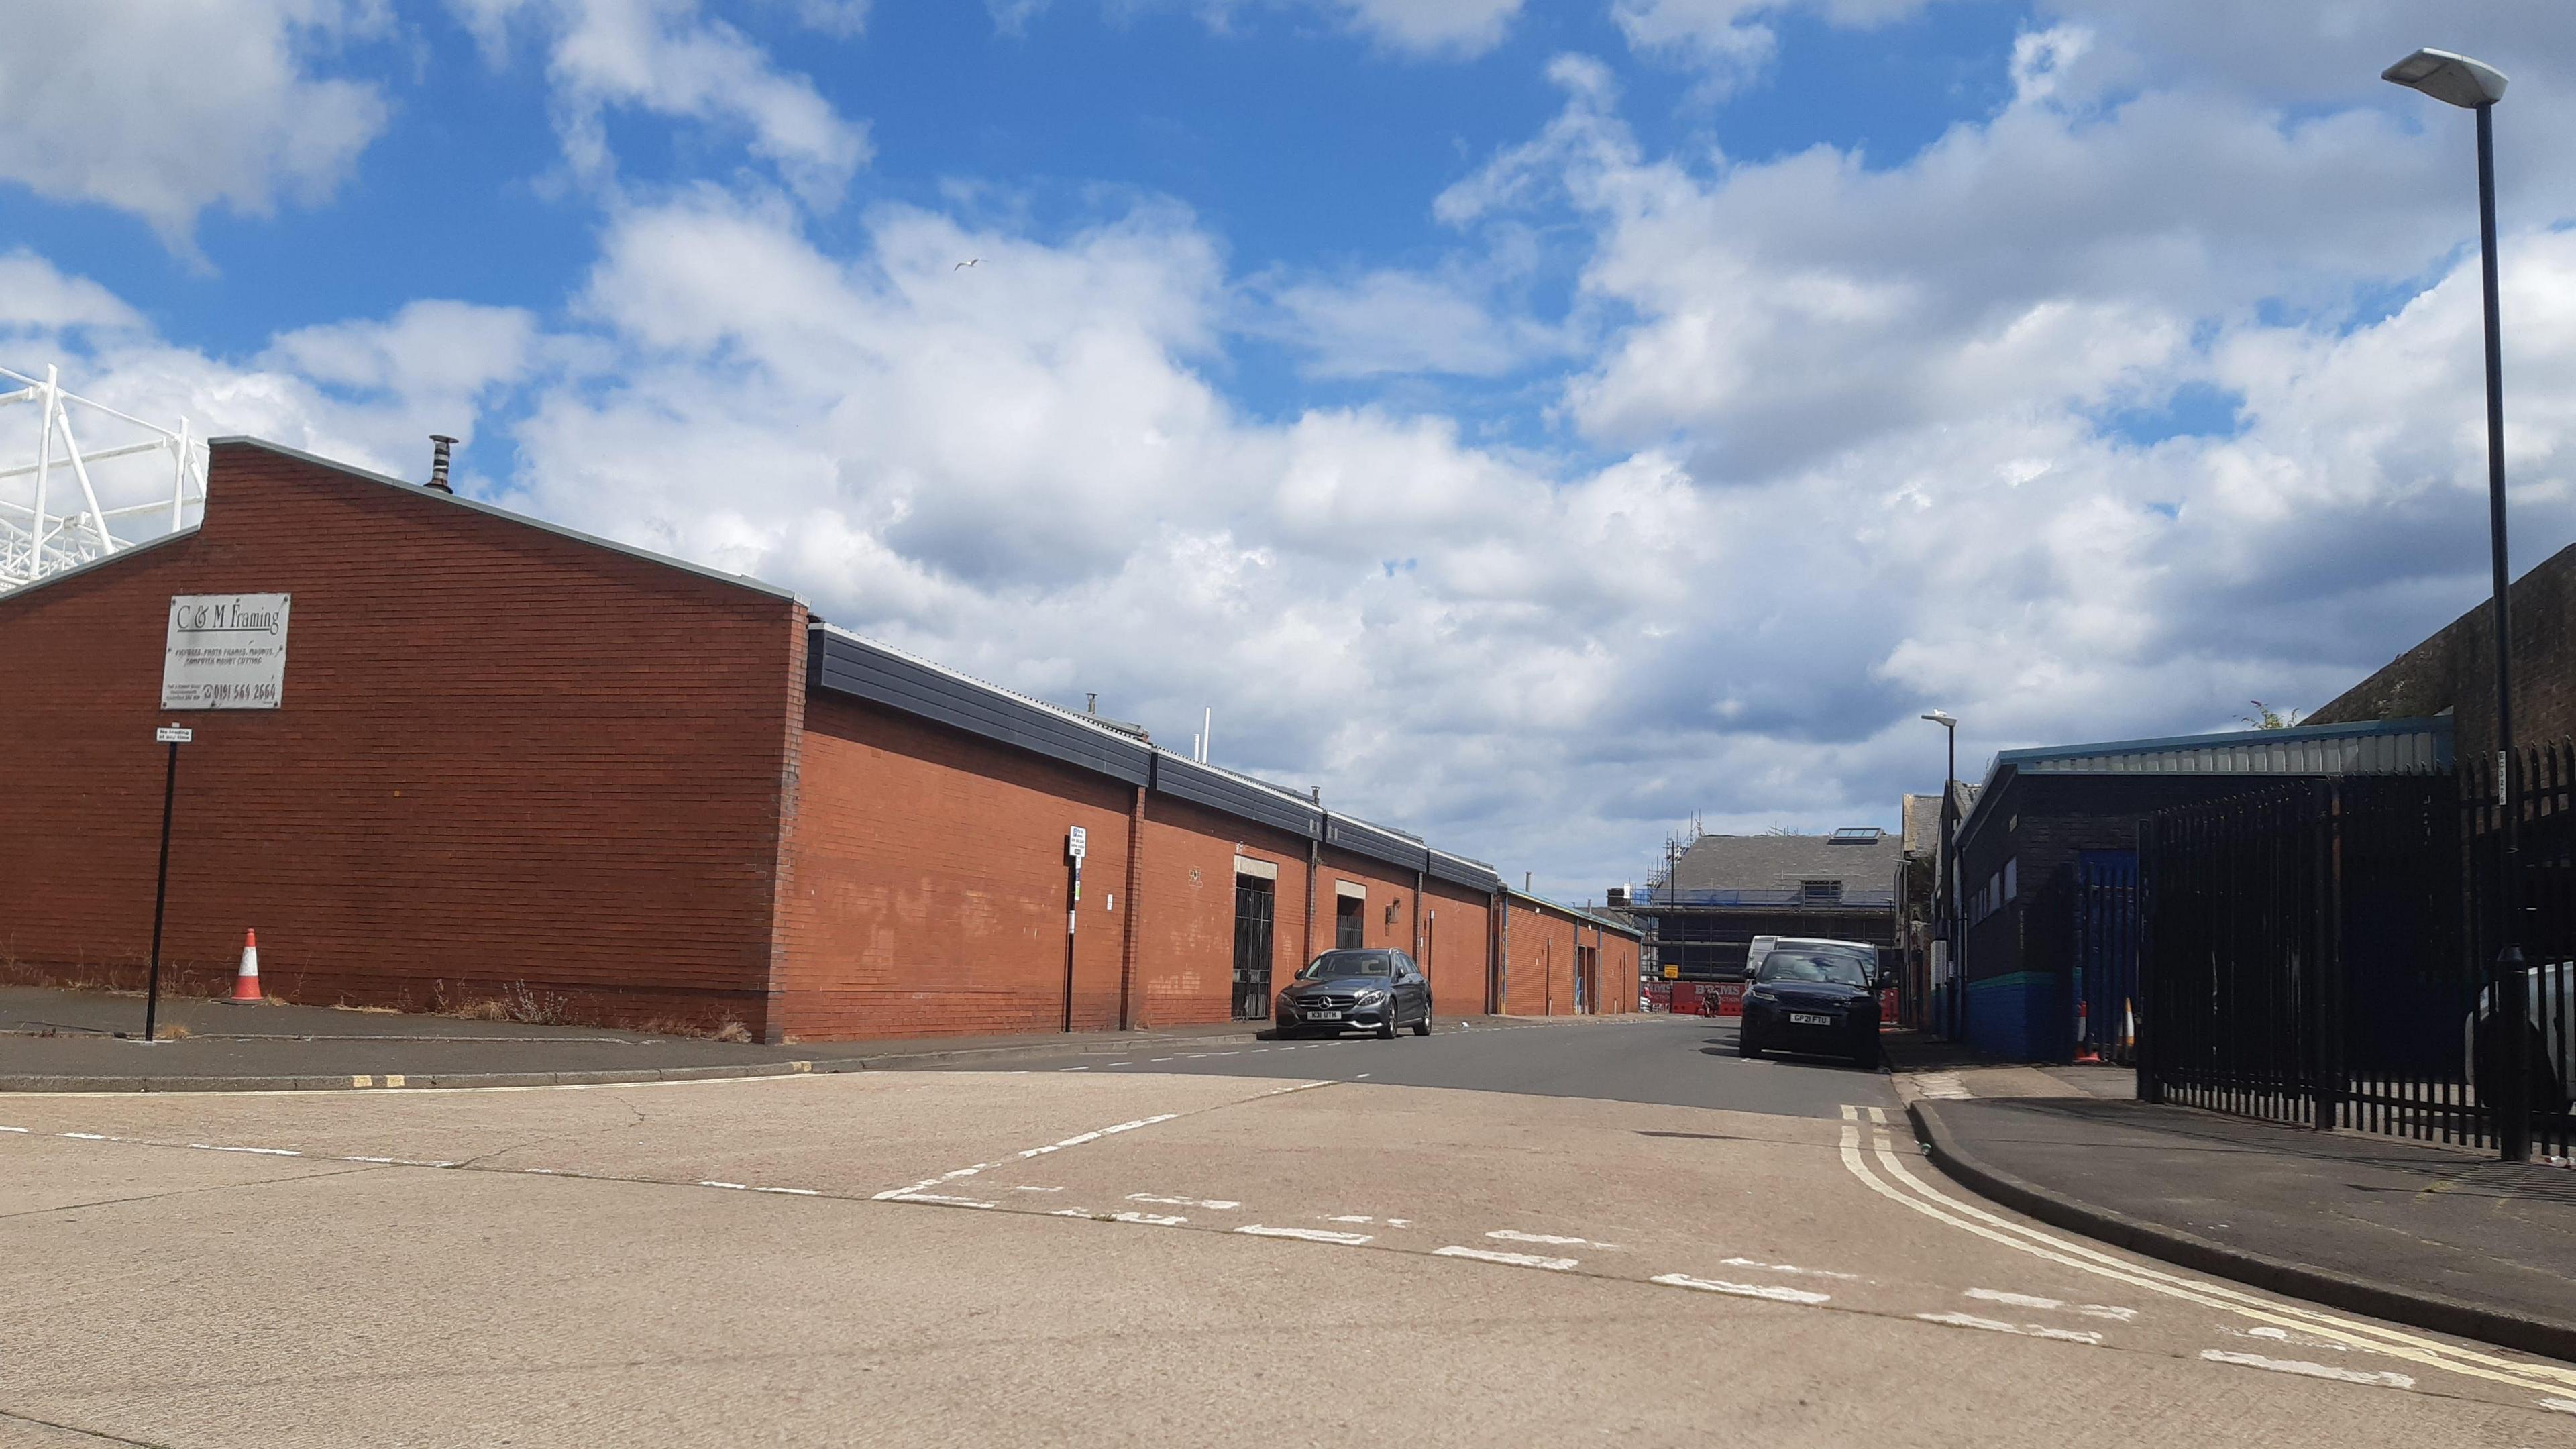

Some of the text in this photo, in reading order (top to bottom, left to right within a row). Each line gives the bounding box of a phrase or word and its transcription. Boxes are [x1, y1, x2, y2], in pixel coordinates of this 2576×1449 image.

[177, 604, 279, 635] C & M Framing
[214, 683, 276, 700] 0191 564 2664
